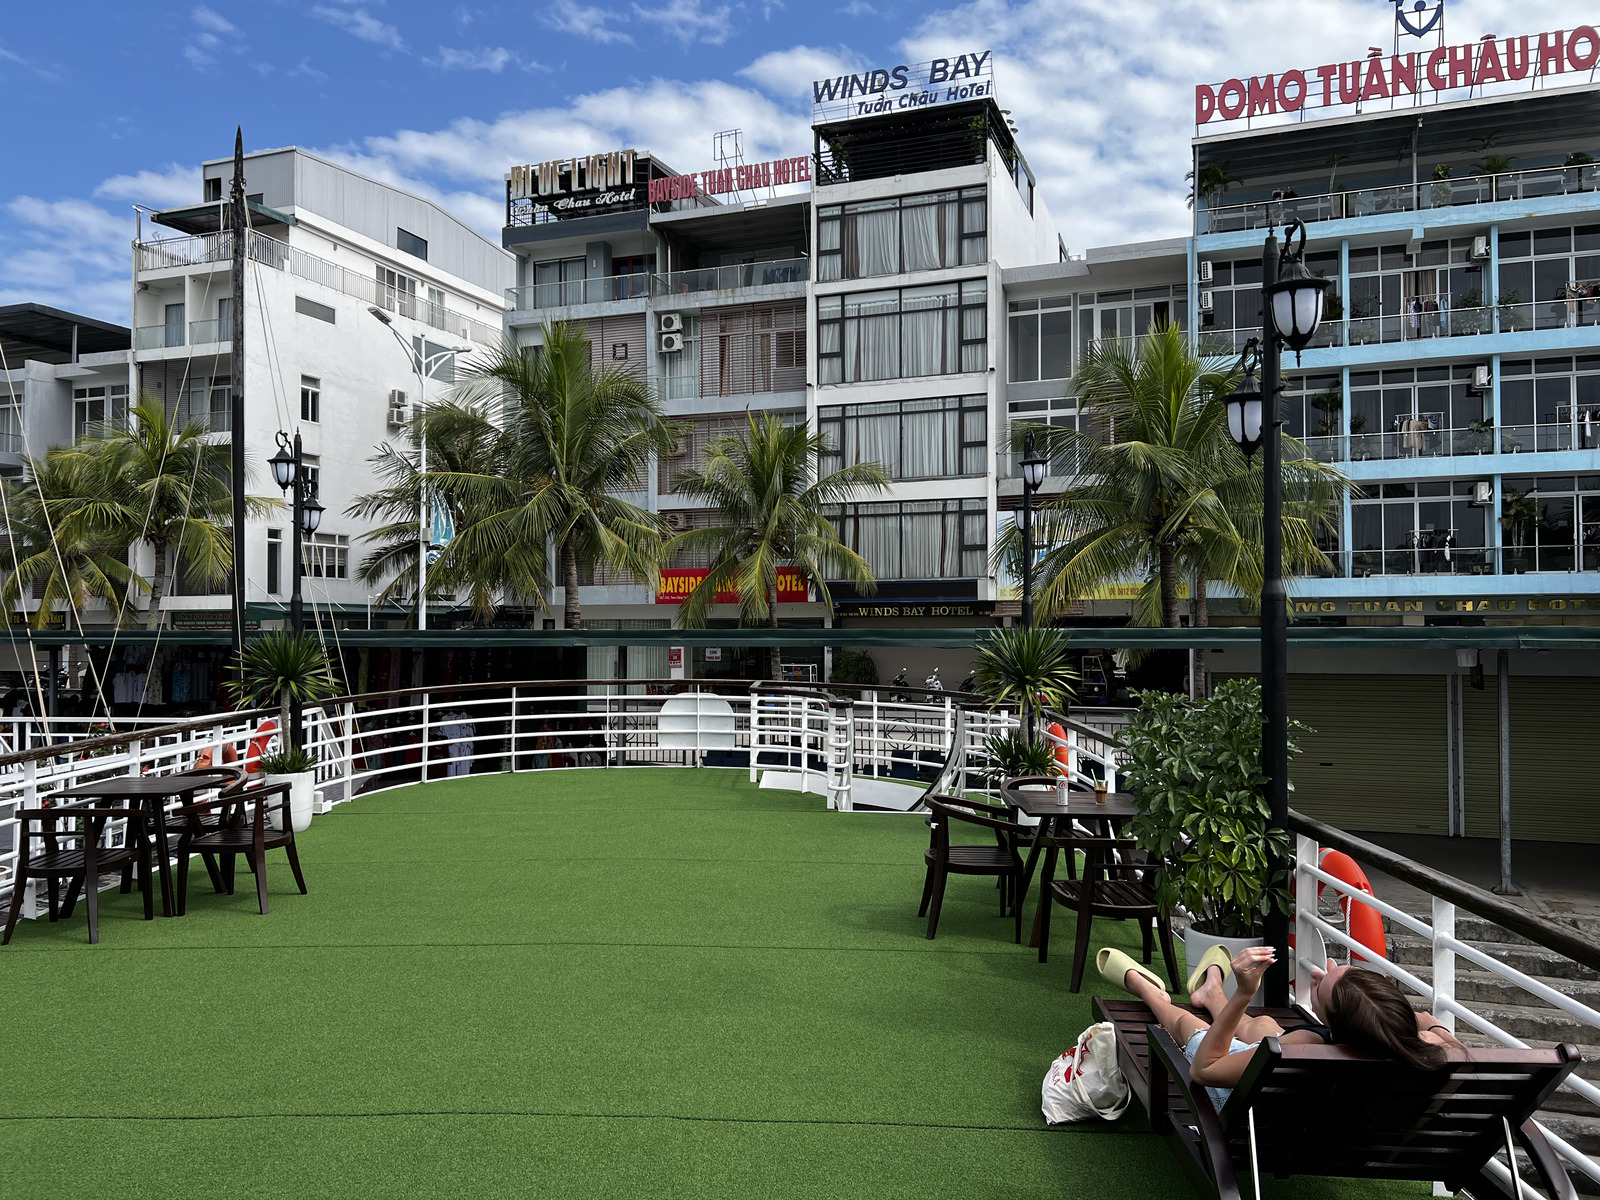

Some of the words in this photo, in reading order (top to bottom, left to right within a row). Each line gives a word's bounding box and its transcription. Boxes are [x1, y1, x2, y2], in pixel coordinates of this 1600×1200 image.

[813, 65, 909, 104] WINDS
[929, 50, 991, 84] BAY
[1196, 69, 1307, 125] DOMO
[1427, 34, 1529, 91] CHÂU
[511, 159, 566, 200] BLUE
[571, 149, 636, 192] LIGHT
[595, 188, 635, 205] Hotel
[648, 172, 698, 203] BAYSIDE
[701, 167, 733, 196] TUAN
[736, 161, 770, 191] CHAU
[773, 155, 811, 186] HOTEL
[775, 574, 804, 592] OTEL
[858, 607, 900, 616] WINDS
[902, 607, 926, 616] BAY
[931, 606, 974, 616] HOTEL
